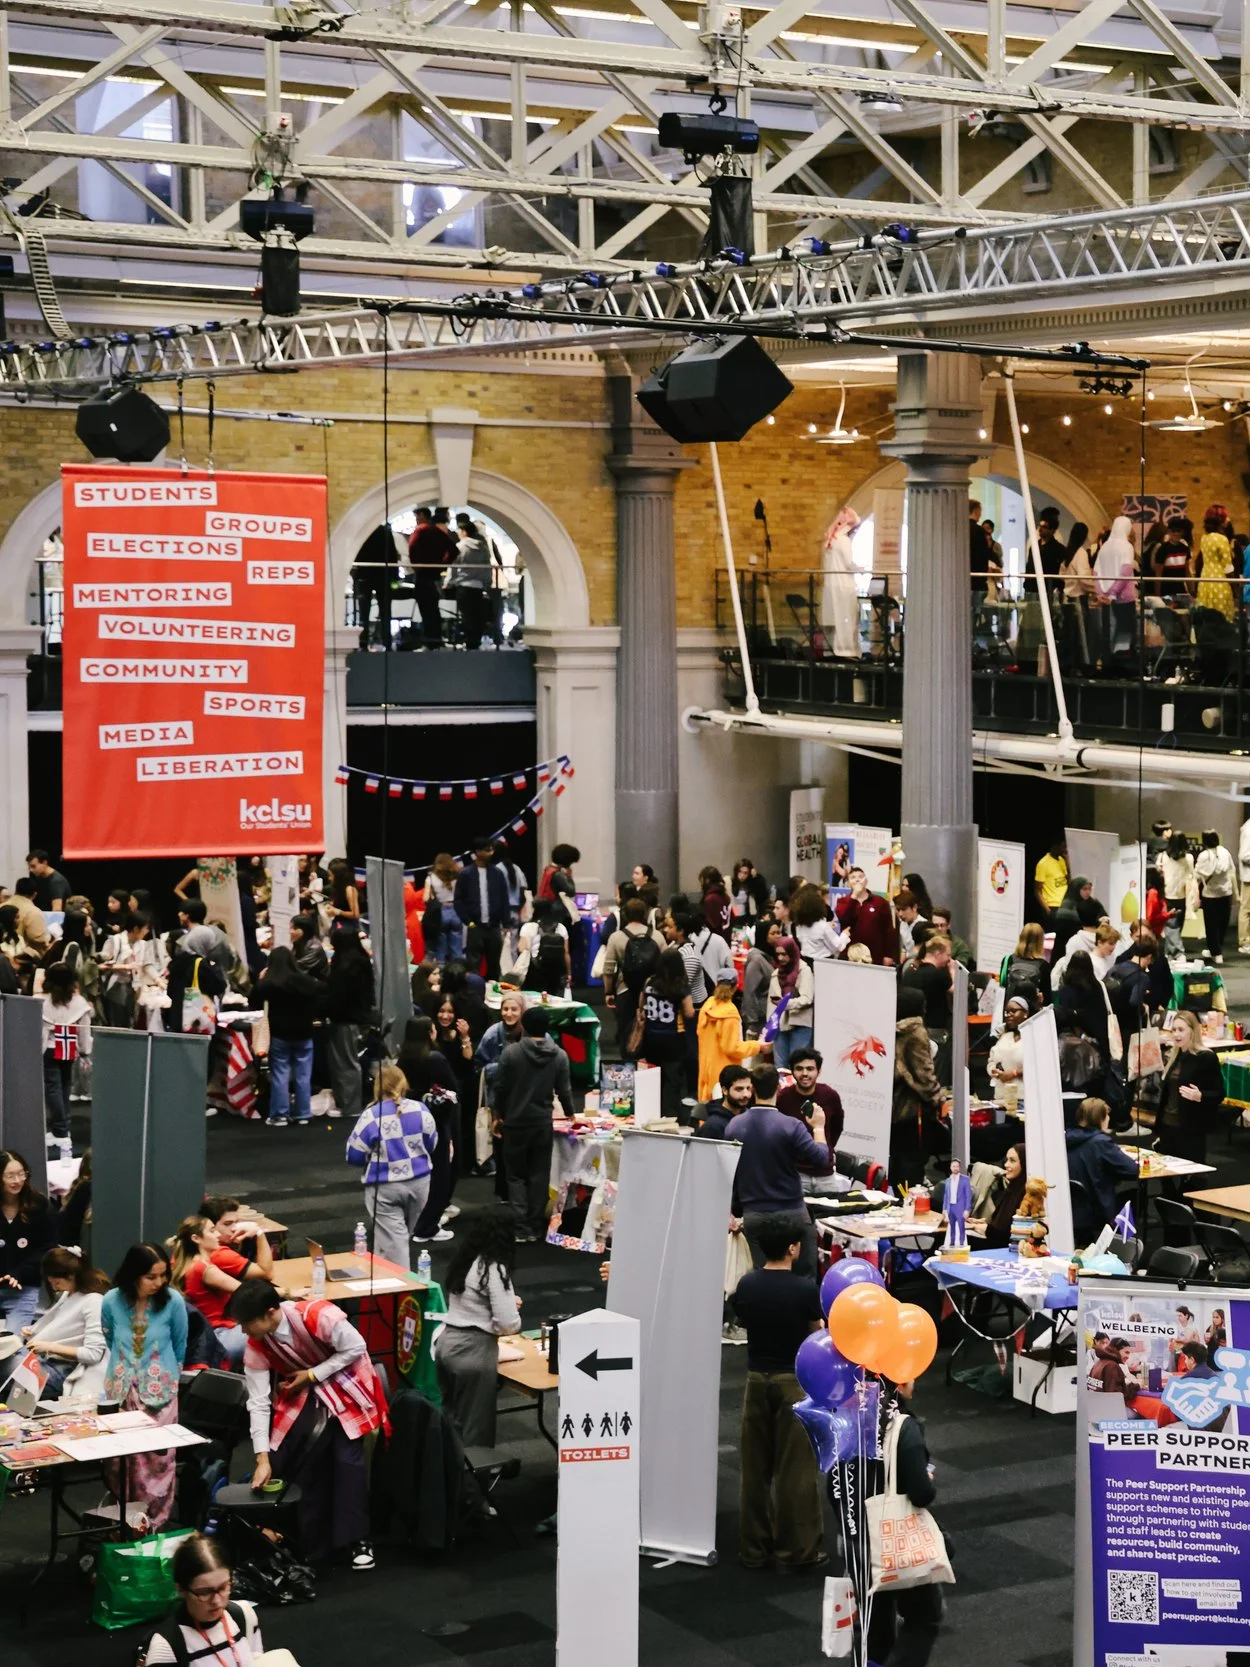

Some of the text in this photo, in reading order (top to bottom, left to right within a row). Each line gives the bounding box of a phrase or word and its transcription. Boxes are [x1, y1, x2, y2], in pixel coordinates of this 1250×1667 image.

[80, 487, 213, 501] STUDENTS
[210, 517, 307, 536] GROUPS
[92, 538, 238, 556] ELECTIONS
[252, 567, 310, 579] REPS
[78, 587, 228, 602] MENTORING
[104, 620, 291, 642] VOLUNTEERING
[85, 664, 243, 678] COMMUNITY
[209, 697, 301, 714] SPORTS
[104, 726, 188, 743] MEDIA
[142, 756, 300, 776] LIBERATION
[240, 798, 312, 822] kclsu
[1101, 1321, 1176, 1335] WELLBEING
[1100, 1421, 1156, 1430] BECOME A
[1107, 1433, 1159, 1446] PEER
[562, 1448, 629, 1461] TOILETS
[1106, 1478, 1246, 1497] The Peer Support Partnership
[1106, 1492, 1149, 1501] supports
[1173, 1495, 1190, 1503] and
[1192, 1496, 1229, 1507] existing
[1106, 1503, 1144, 1513] support
[1147, 1505, 1188, 1514] schemes
[1203, 1507, 1230, 1517] thrive
[1106, 1514, 1144, 1525] through
[1147, 1517, 1196, 1529] partnering
[1199, 1519, 1219, 1528] with
[1127, 1526, 1148, 1535] staff
[1151, 1527, 1175, 1537] leads
[1190, 1531, 1221, 1540] create
[1107, 1537, 1240, 1554] resources, build community,
[1107, 1549, 1221, 1563] and share best practice.
[1107, 1654, 1136, 1662] Connect
